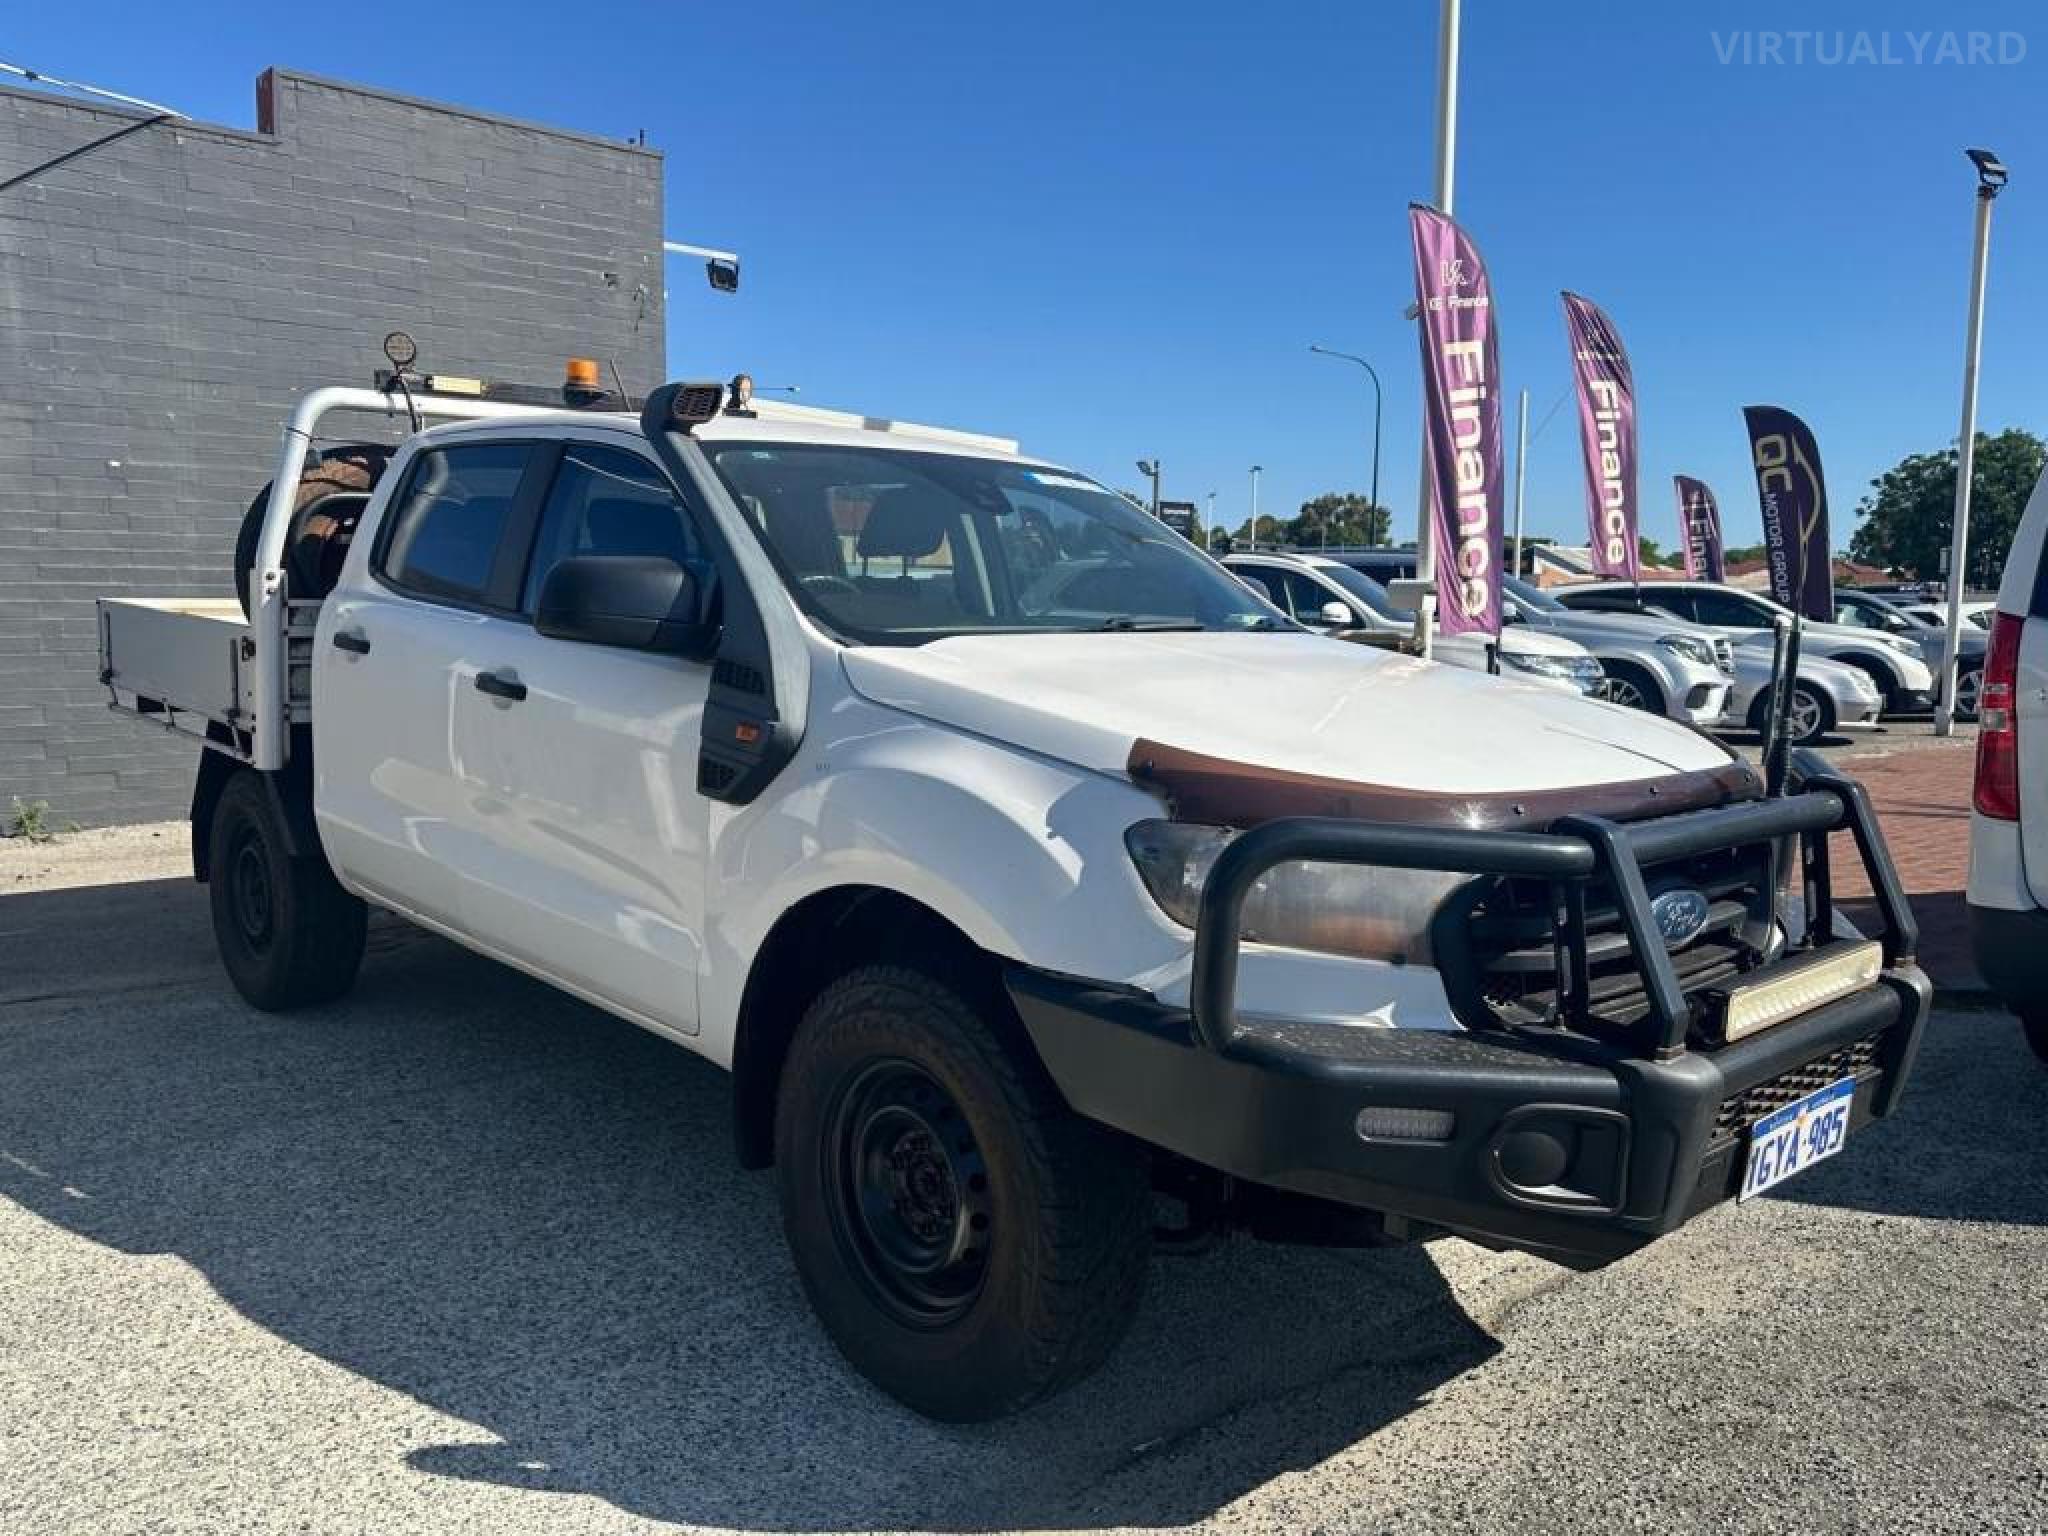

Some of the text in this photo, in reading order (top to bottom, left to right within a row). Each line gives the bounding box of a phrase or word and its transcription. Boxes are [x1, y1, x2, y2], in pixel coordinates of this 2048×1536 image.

[1445, 339, 1489, 614] Finance
[1591, 380, 1626, 562] Finance
[1755, 434, 1792, 602] QC MOTOR GROUP
